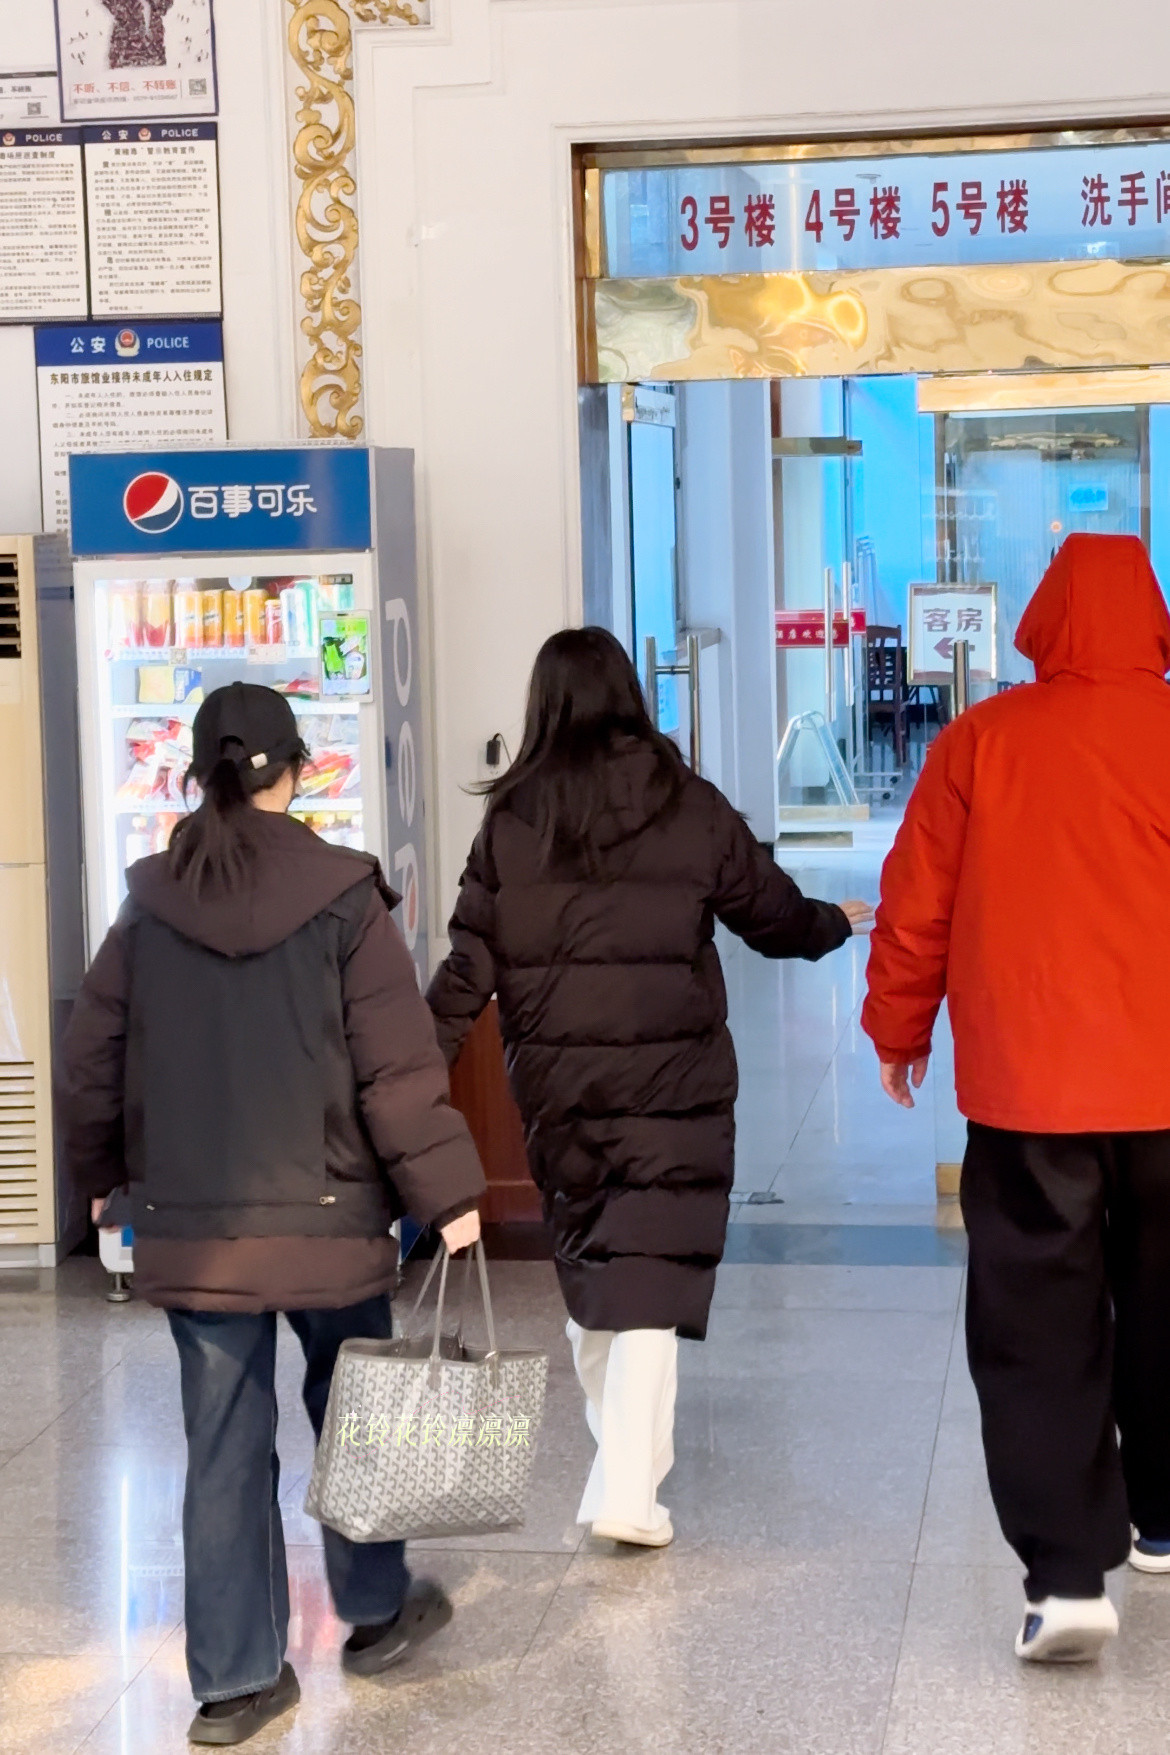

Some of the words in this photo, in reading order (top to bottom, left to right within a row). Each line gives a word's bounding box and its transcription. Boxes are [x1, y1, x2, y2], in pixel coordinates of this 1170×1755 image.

[25, 133, 63, 142] POLICE
[101, 129, 129, 141] 公安
[161, 128, 199, 138] POLICE
[680, 193, 776, 251] 3号楼
[804, 186, 902, 243] 4号楼
[931, 179, 1029, 237] 5号楼
[70, 336, 106, 353] 公安
[147, 337, 189, 349] POLICE
[50, 369, 213, 385] 东阳市旅馆业接待未成年人入住规定
[188, 484, 318, 519] 百事可乐
[923, 607, 983, 633] 客房
